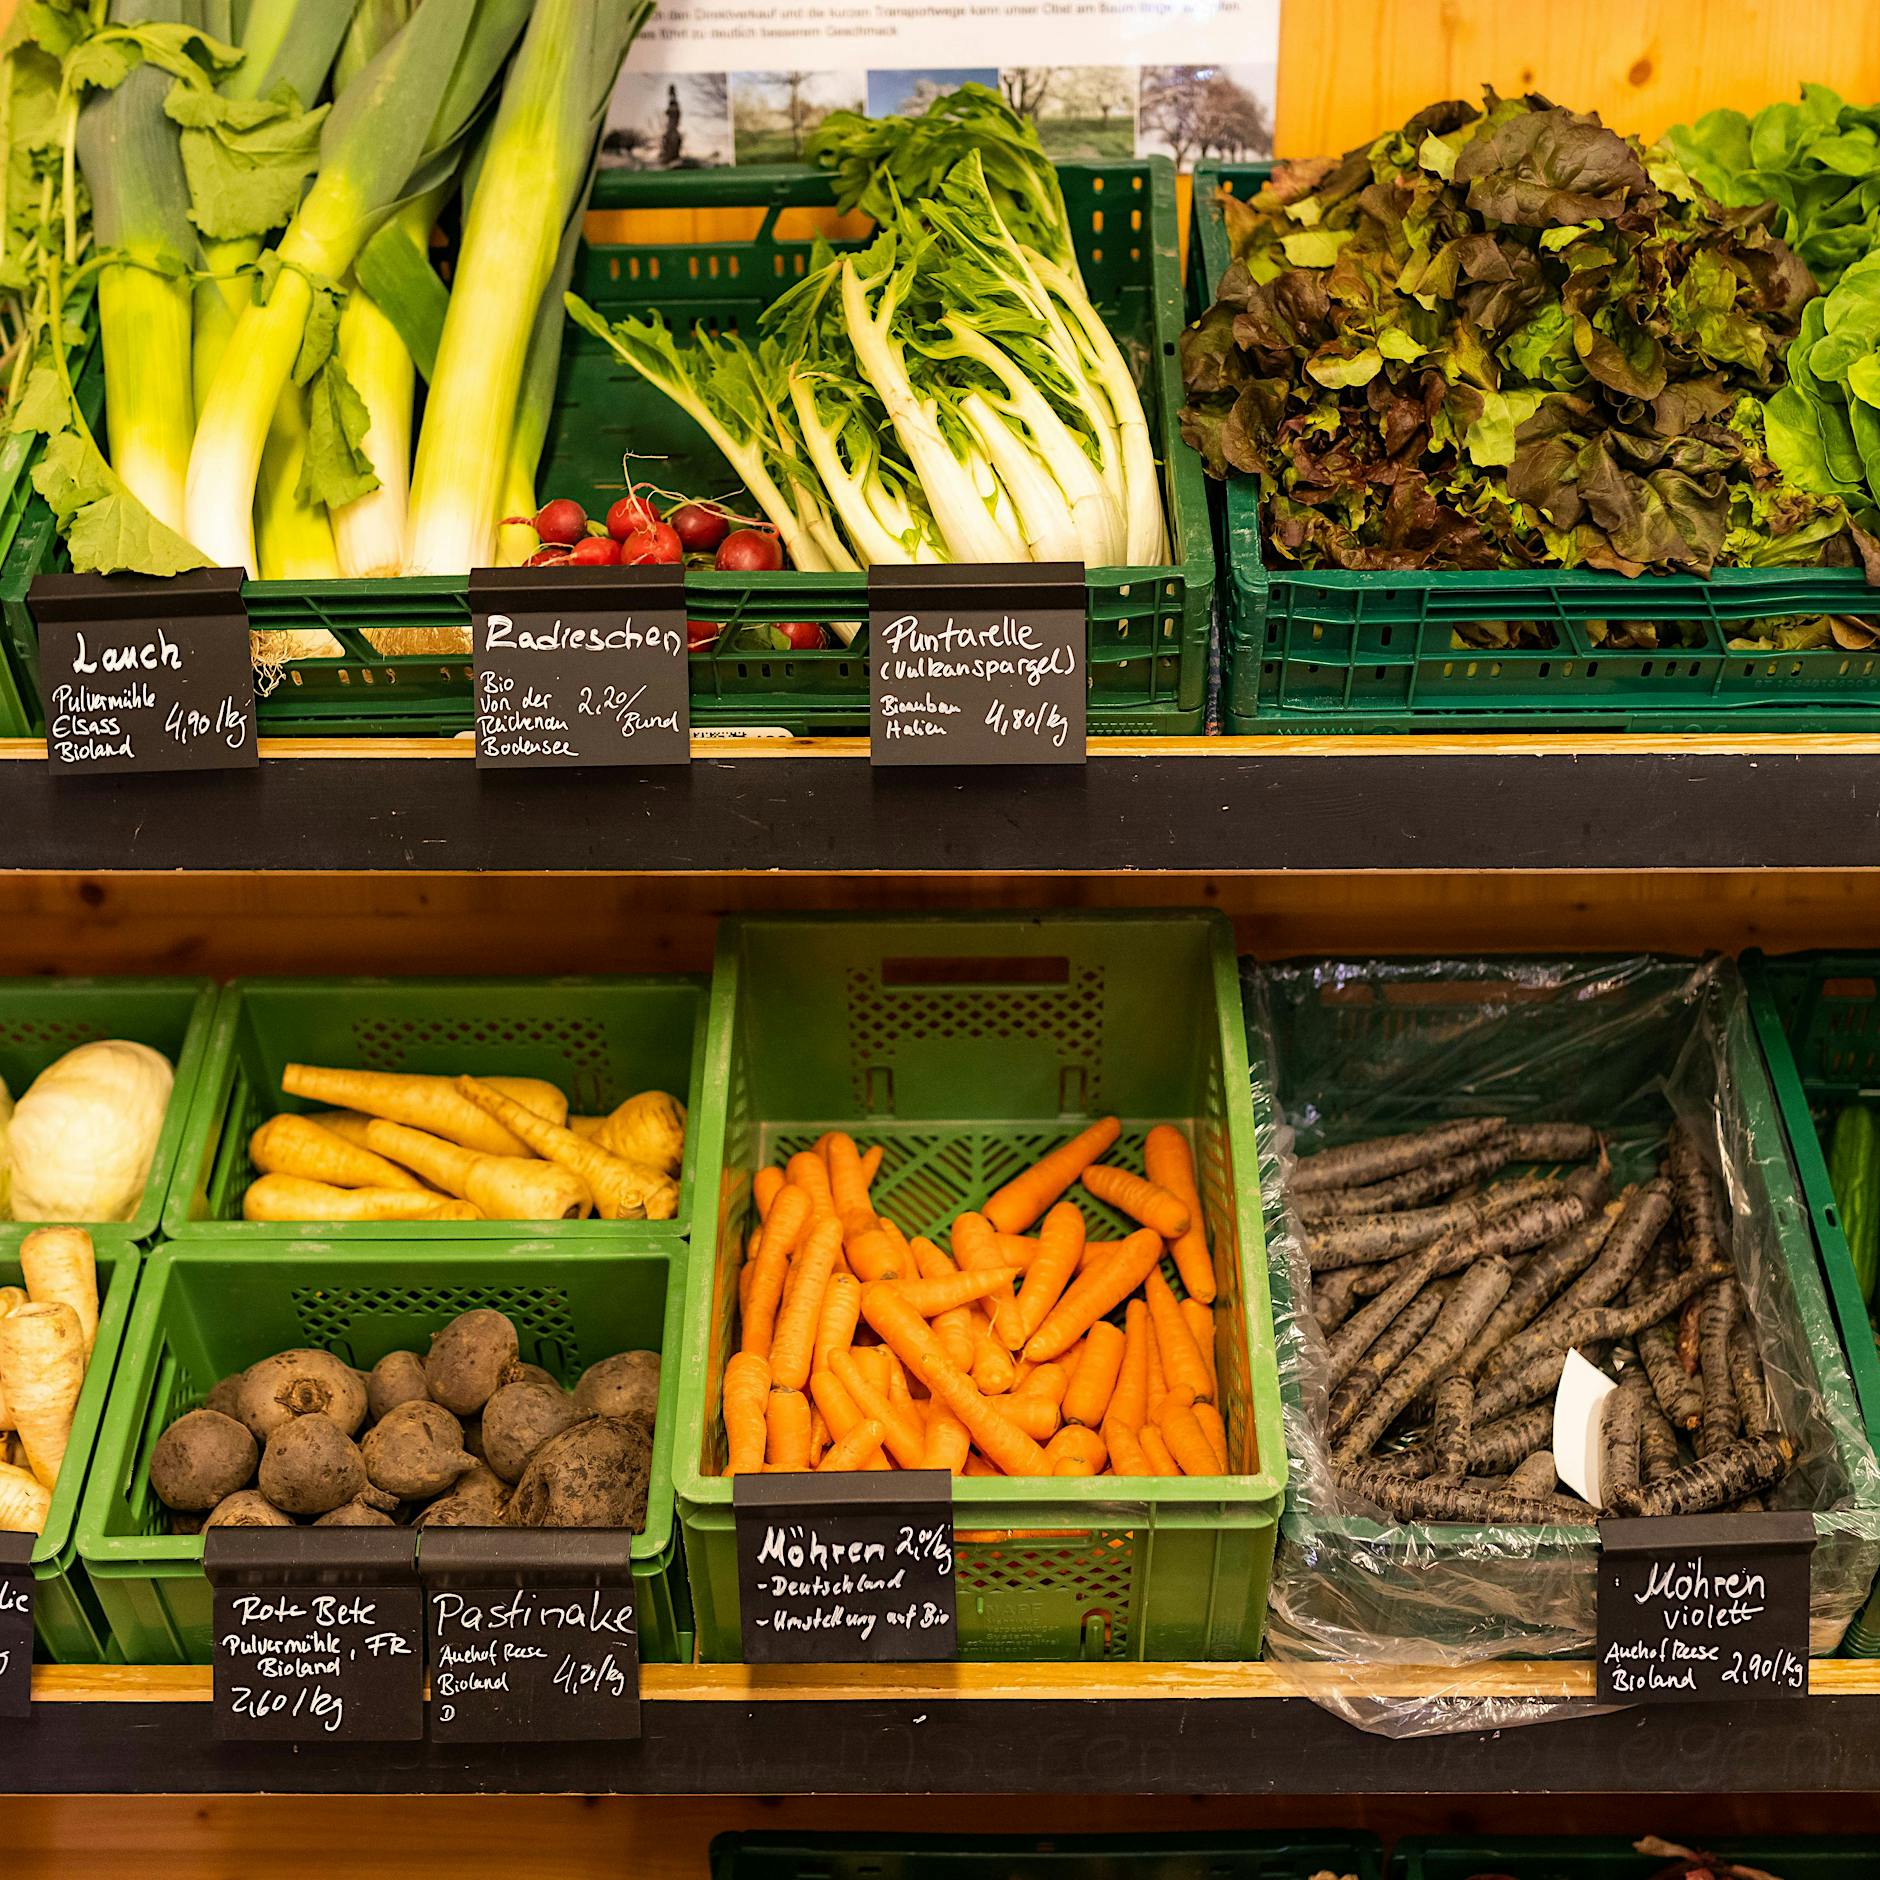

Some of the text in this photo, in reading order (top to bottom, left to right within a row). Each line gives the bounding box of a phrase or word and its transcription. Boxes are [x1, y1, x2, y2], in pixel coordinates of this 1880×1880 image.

[485, 614, 682, 657] Radieschen
[881, 615, 1044, 654] Puntarelle
[72, 628, 182, 674] Lauch
[479, 670, 515, 694] Bio
[51, 681, 156, 714] Pulvermühle
[521, 686, 553, 710] der
[52, 714, 121, 738] Elsass
[53, 733, 135, 763] Bioland
[480, 734, 580, 757] Bodensee
[756, 1525, 885, 1571] Möhren
[1634, 1556, 1765, 1605] Möhren
[232, 1595, 376, 1627] Rote Bete
[432, 1589, 636, 1636] Pastinake
[886, 1603, 917, 1630] auf
[919, 1601, 950, 1629] Bio
[1663, 1601, 1765, 1630] violett
[364, 1632, 412, 1657] FR
[256, 1656, 340, 1678] Bioland
[1611, 1668, 1697, 1692] Bioland
[437, 1671, 510, 1696] Bioland
[439, 1704, 456, 1722] D
